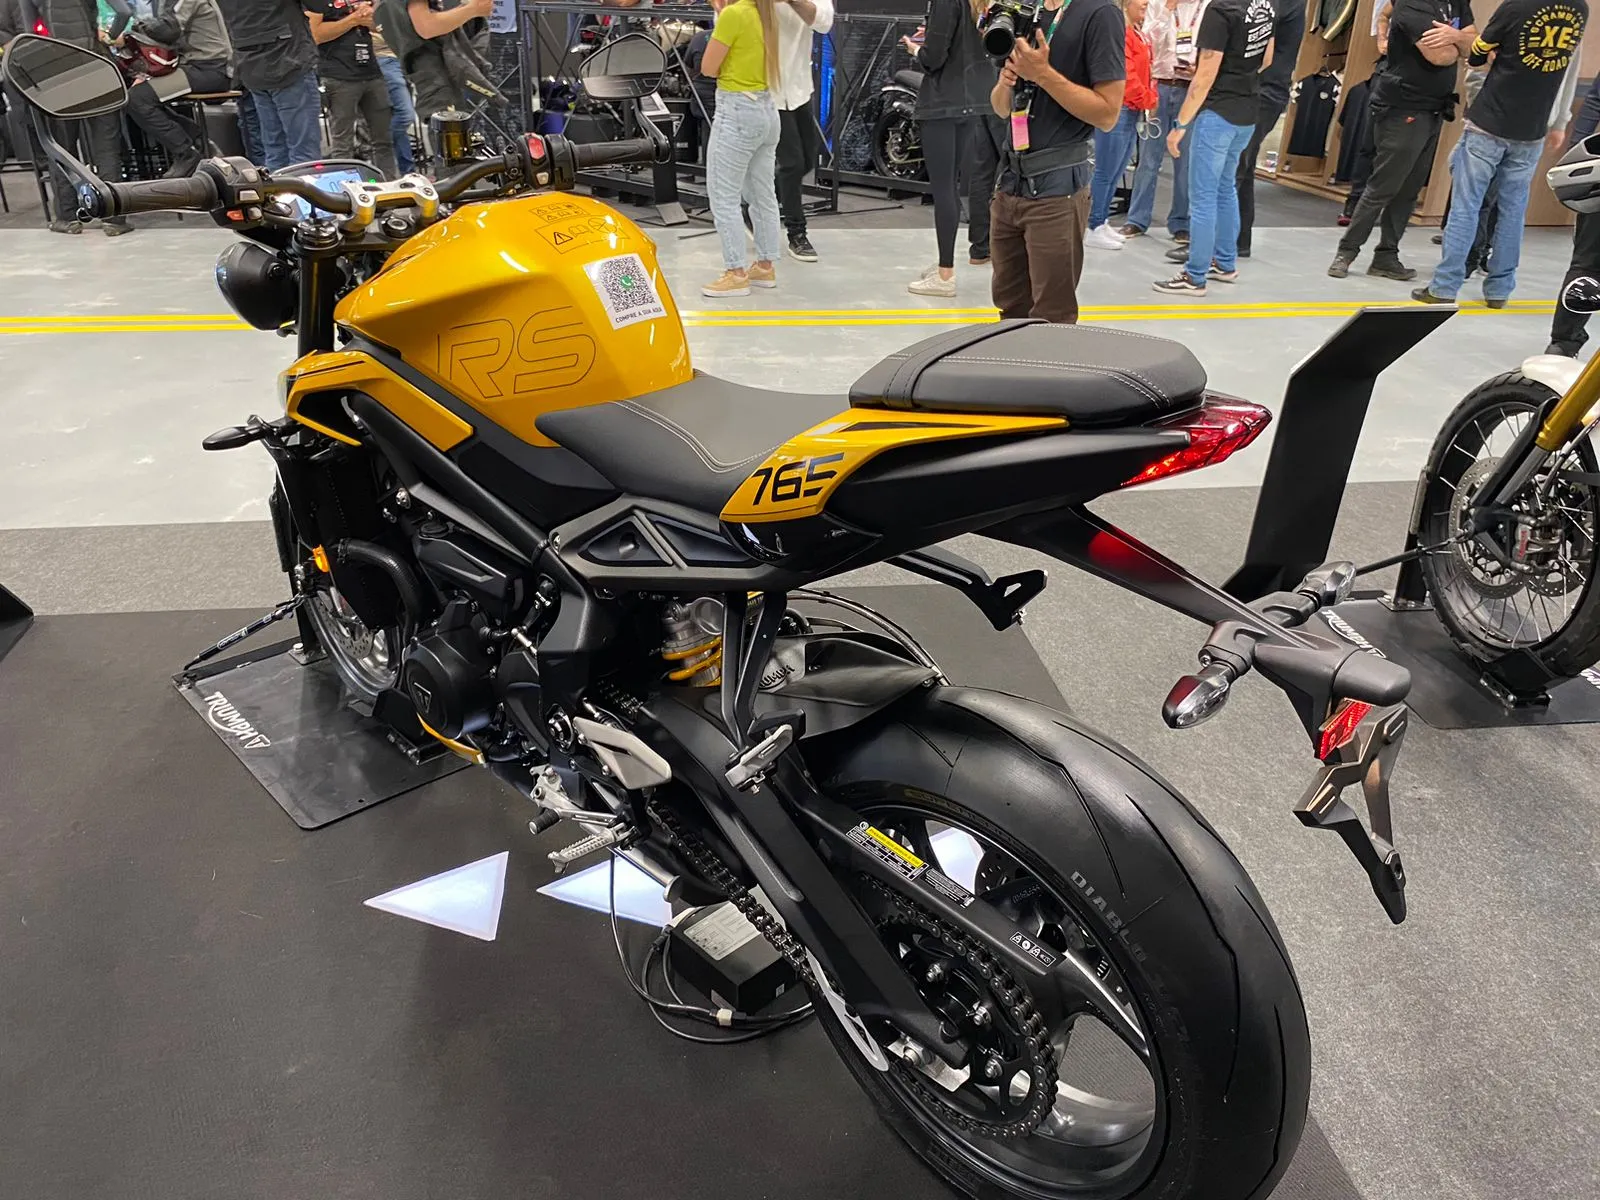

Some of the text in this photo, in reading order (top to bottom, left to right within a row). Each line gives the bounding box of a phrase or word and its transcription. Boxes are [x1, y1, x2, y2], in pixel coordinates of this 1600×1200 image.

[1540, 26, 1573, 48] XE
[1522, 53, 1543, 69] OFF
[1541, 56, 1568, 72] ROAD
[615, 313, 637, 323] COMPRE
[431, 305, 596, 399] RS
[751, 452, 845, 506] 765
[1321, 609, 1374, 649] TRIUMPH
[204, 691, 259, 740] TRIUMPH
[1070, 871, 1148, 962] DIABLO
